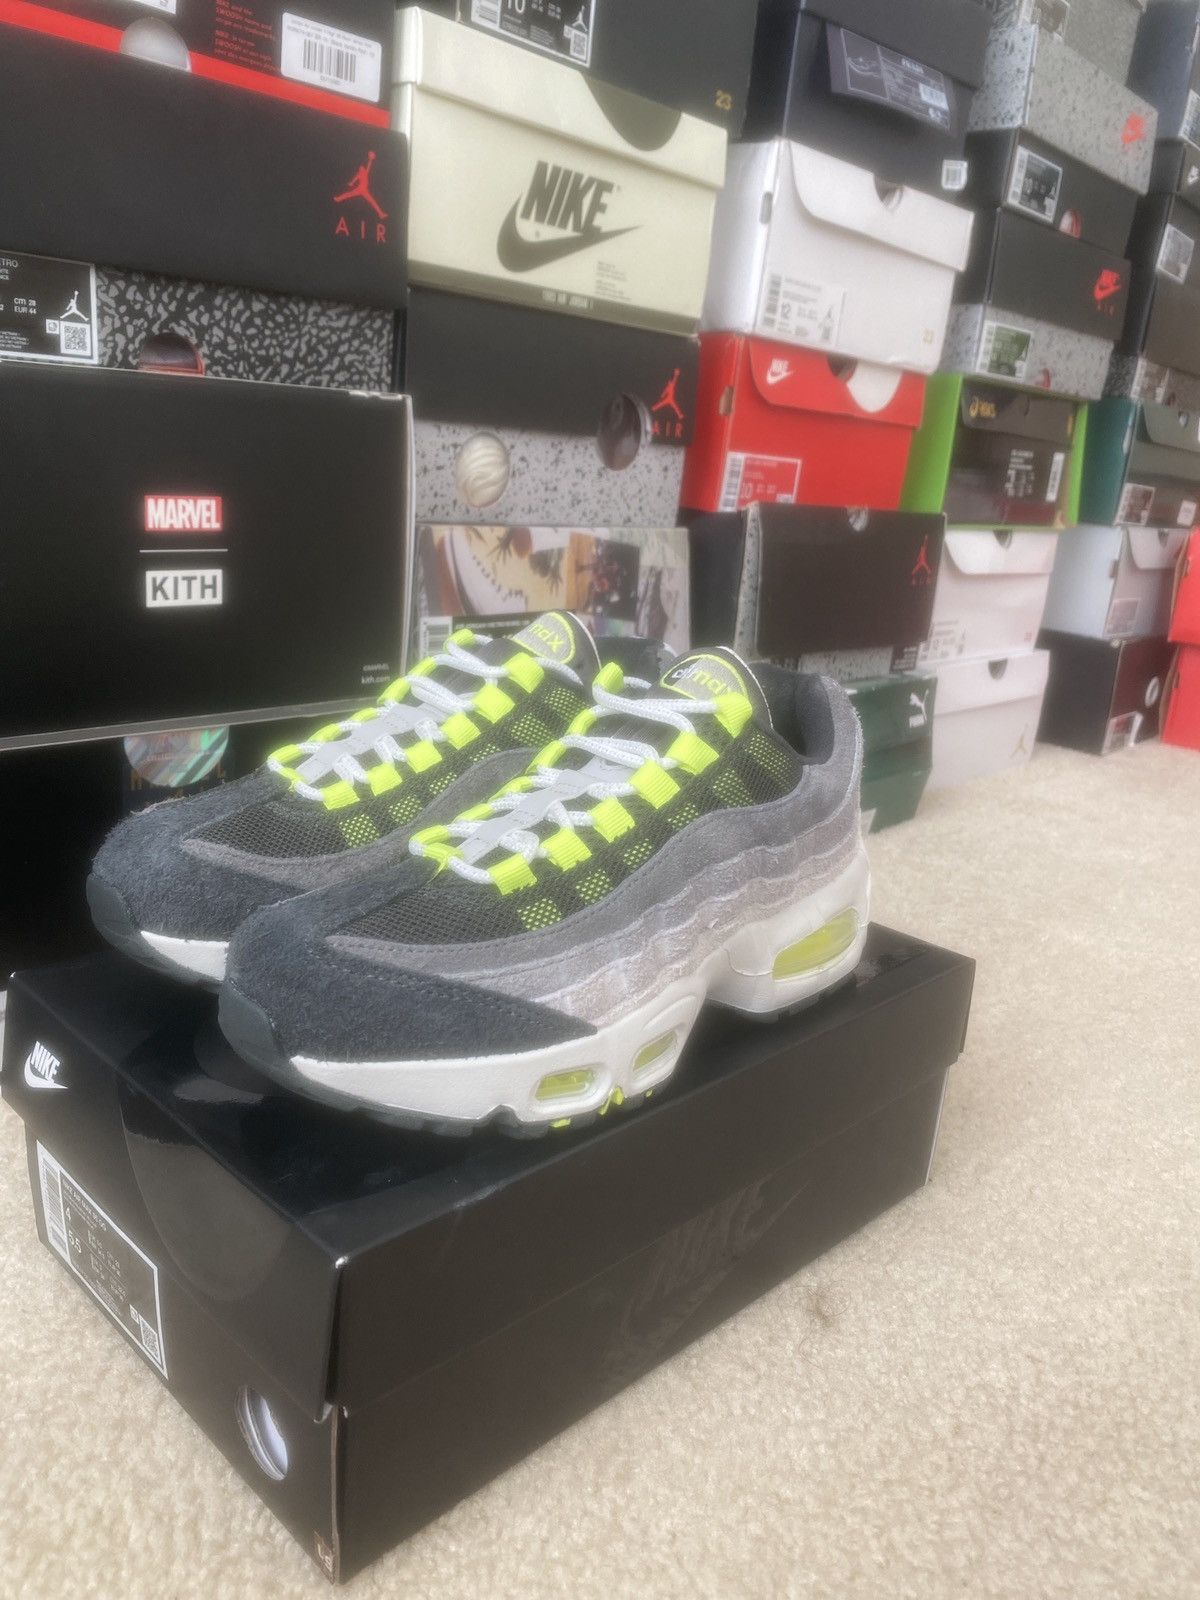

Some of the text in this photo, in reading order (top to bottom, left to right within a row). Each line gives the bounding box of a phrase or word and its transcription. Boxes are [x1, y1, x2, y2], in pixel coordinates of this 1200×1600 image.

[520, 160, 614, 235] NIKE
[335, 216, 386, 244] AIR
[0, 258, 18, 268] TRO
[14, 305, 28, 314] EUR
[653, 420, 683, 439] AIR
[147, 498, 222, 530] MARVEL
[151, 575, 218, 602] KITH
[30, 1040, 61, 1083] NIKE
